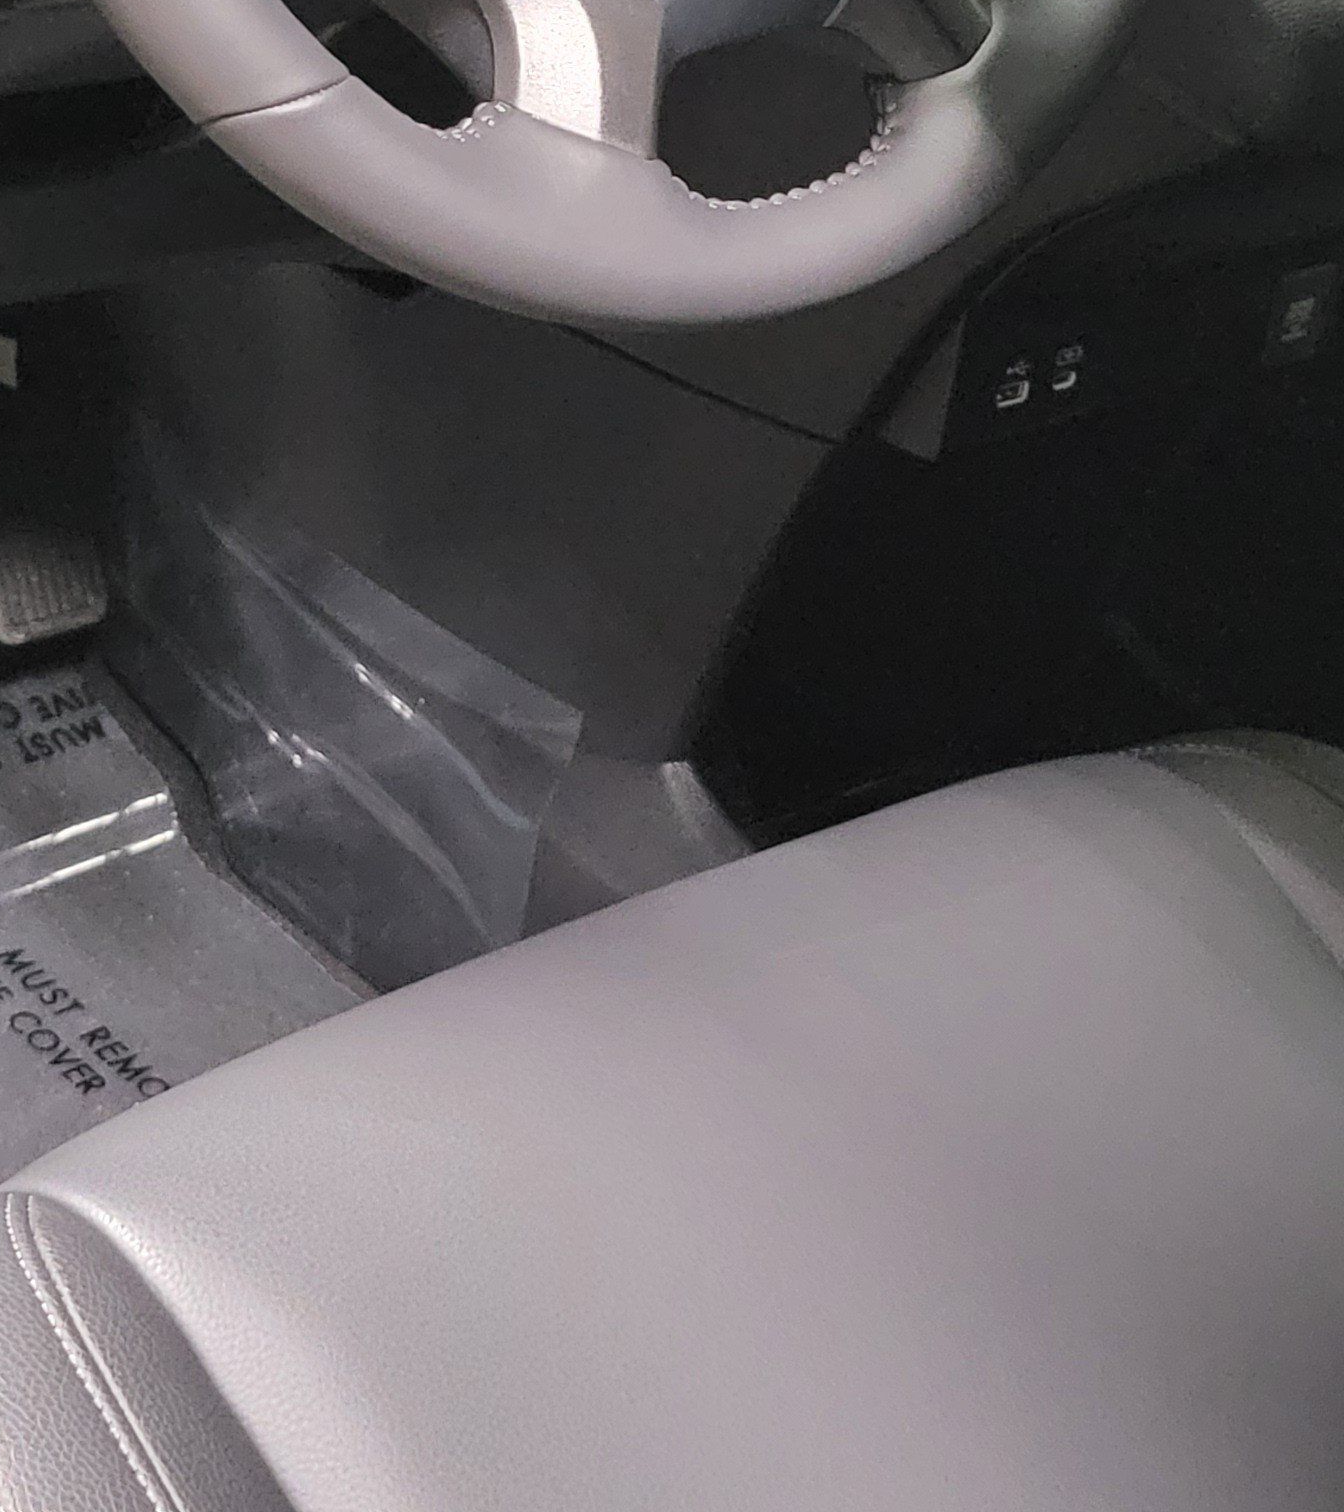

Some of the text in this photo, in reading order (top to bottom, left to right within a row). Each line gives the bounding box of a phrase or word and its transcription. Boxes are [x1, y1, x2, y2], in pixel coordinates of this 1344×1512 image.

[16, 716, 107, 765] MUST
[9, 1010, 106, 1095] COVER
[80, 1025, 171, 1098] REMO
